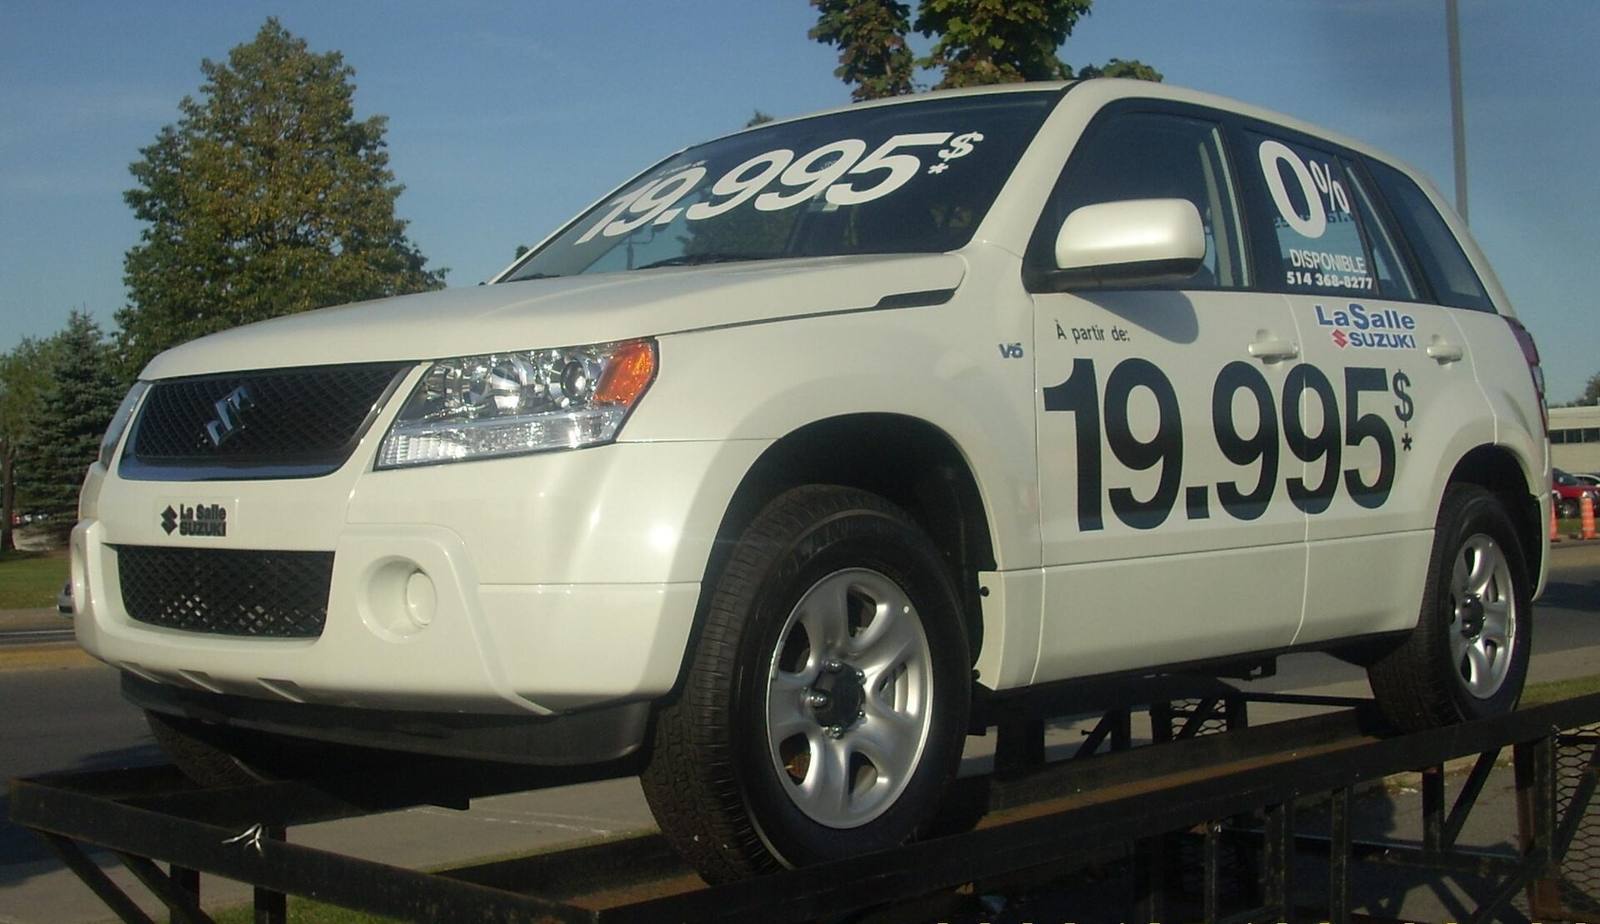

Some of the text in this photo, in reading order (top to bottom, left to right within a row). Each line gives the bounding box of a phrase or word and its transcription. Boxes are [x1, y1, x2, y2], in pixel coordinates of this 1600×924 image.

[1259, 140, 1350, 239] 0%
[1290, 249, 1367, 274] DISPONIBLE
[1287, 271, 1373, 290] 514 368-8277
[1315, 303, 1415, 330] LaSalle
[1071, 324, 1105, 345] partir
[1111, 326, 1131, 342] de:
[1350, 331, 1416, 350] SUZUKI
[998, 341, 1024, 358] V6
[180, 503, 226, 520] La Salle
[179, 520, 226, 537] SUZUKI
